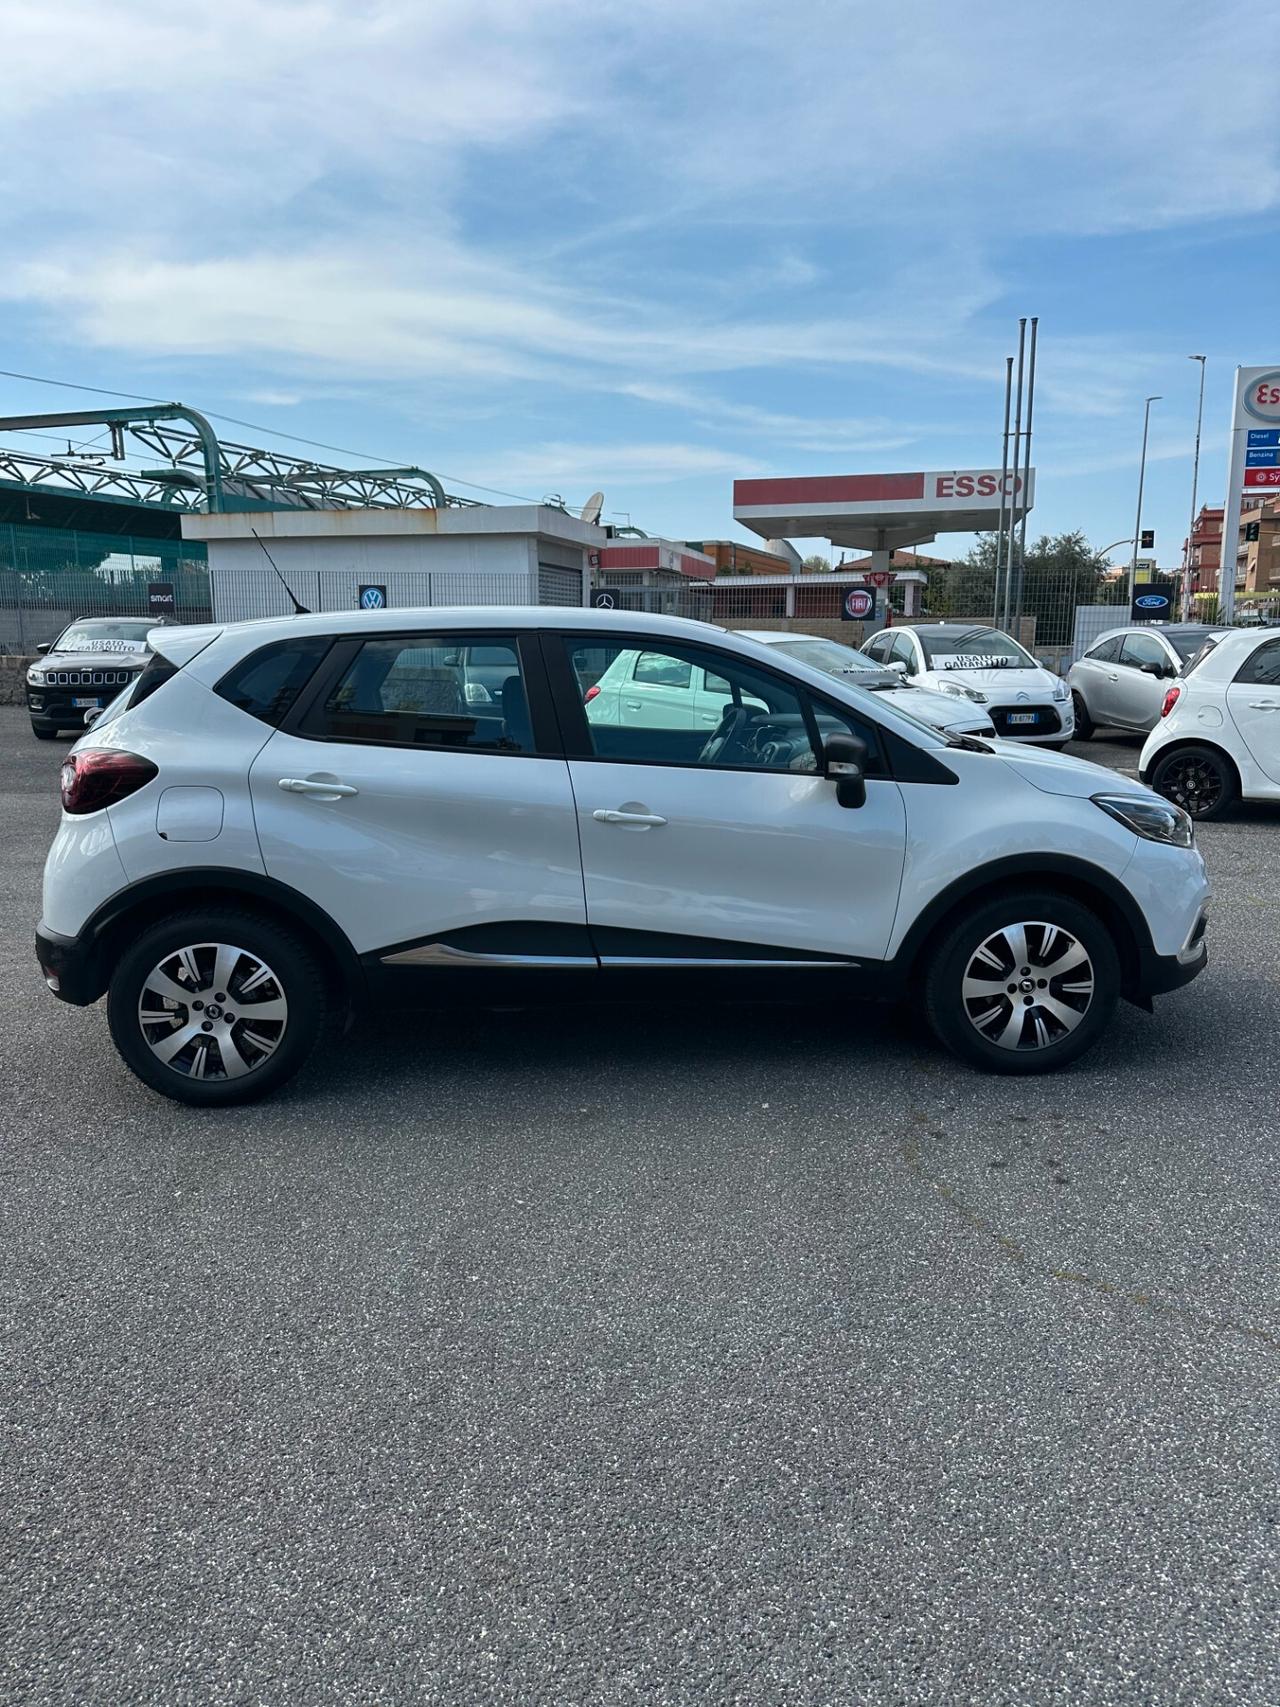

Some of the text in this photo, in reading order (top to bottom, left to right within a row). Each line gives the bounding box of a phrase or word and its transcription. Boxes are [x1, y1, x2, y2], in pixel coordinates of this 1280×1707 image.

[936, 474, 1022, 498] ESSO
[150, 594, 174, 603] smart
[851, 598, 868, 610] FIAT
[1142, 598, 1161, 606] Ford
[944, 656, 1009, 669] GARANTITO
